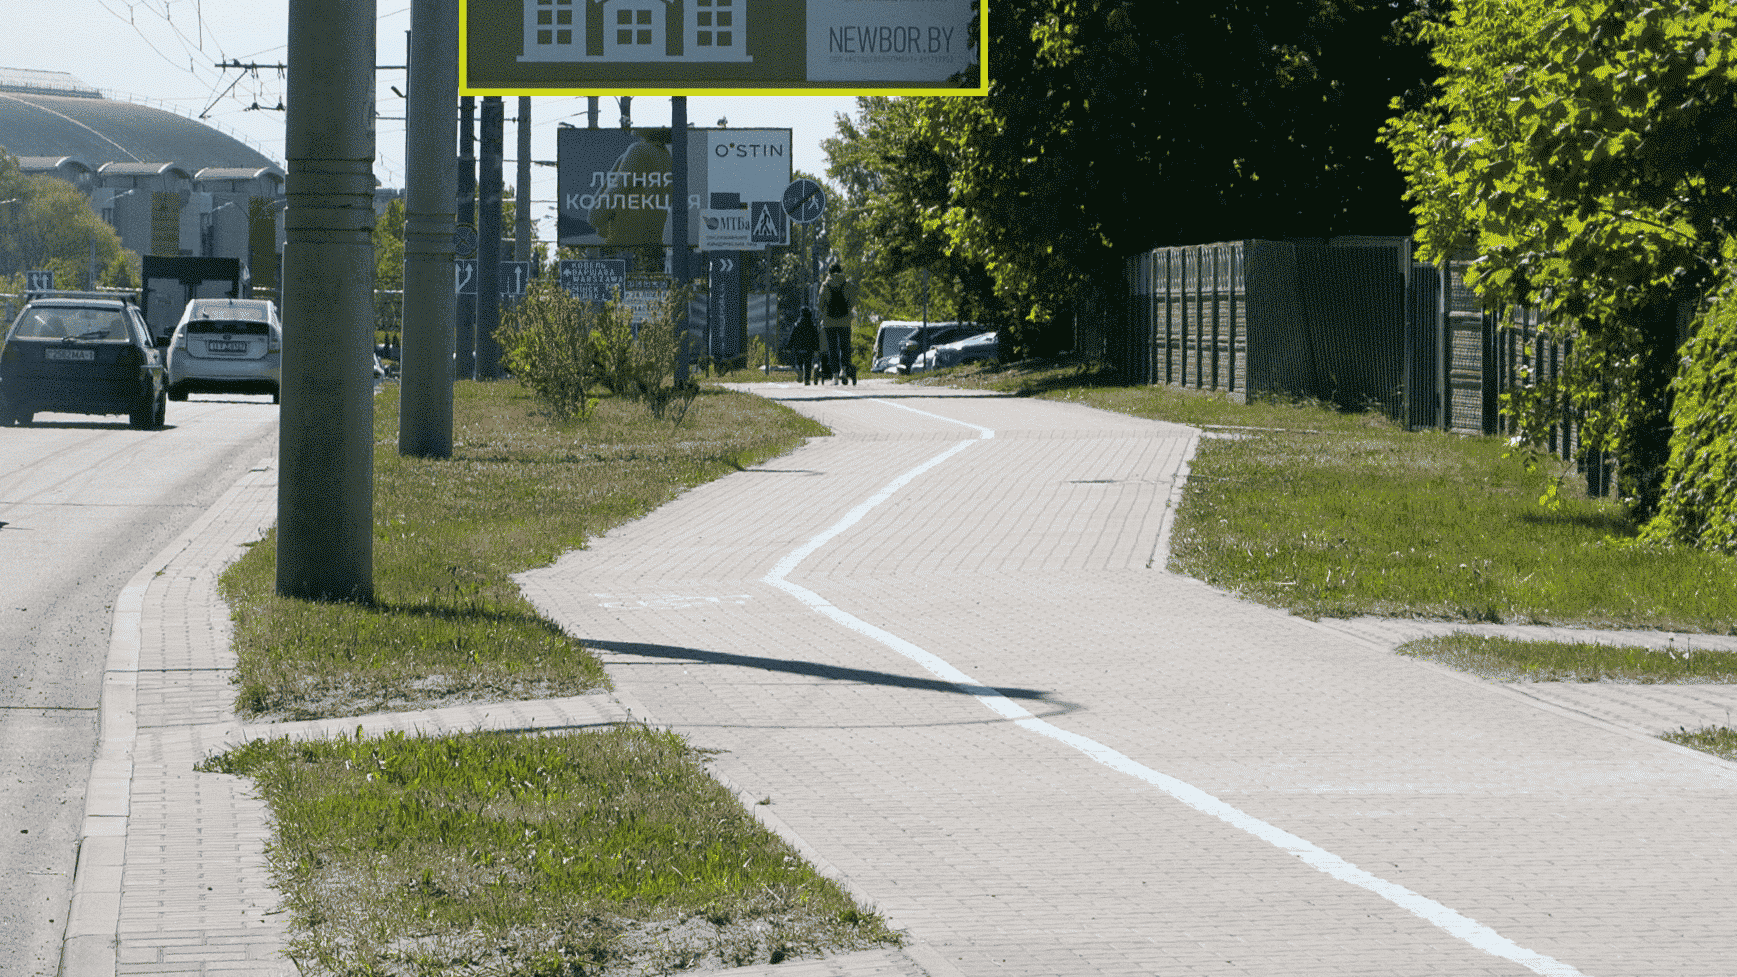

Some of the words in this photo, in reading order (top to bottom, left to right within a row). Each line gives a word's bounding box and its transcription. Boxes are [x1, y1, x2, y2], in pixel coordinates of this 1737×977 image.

[829, 26, 954, 53] NEWBOR.BY
[590, 171, 674, 187] ЛЕТНЯЯ
[566, 194, 700, 212] КОЛЛЕКЦЯ
[720, 217, 750, 230] МТБа
